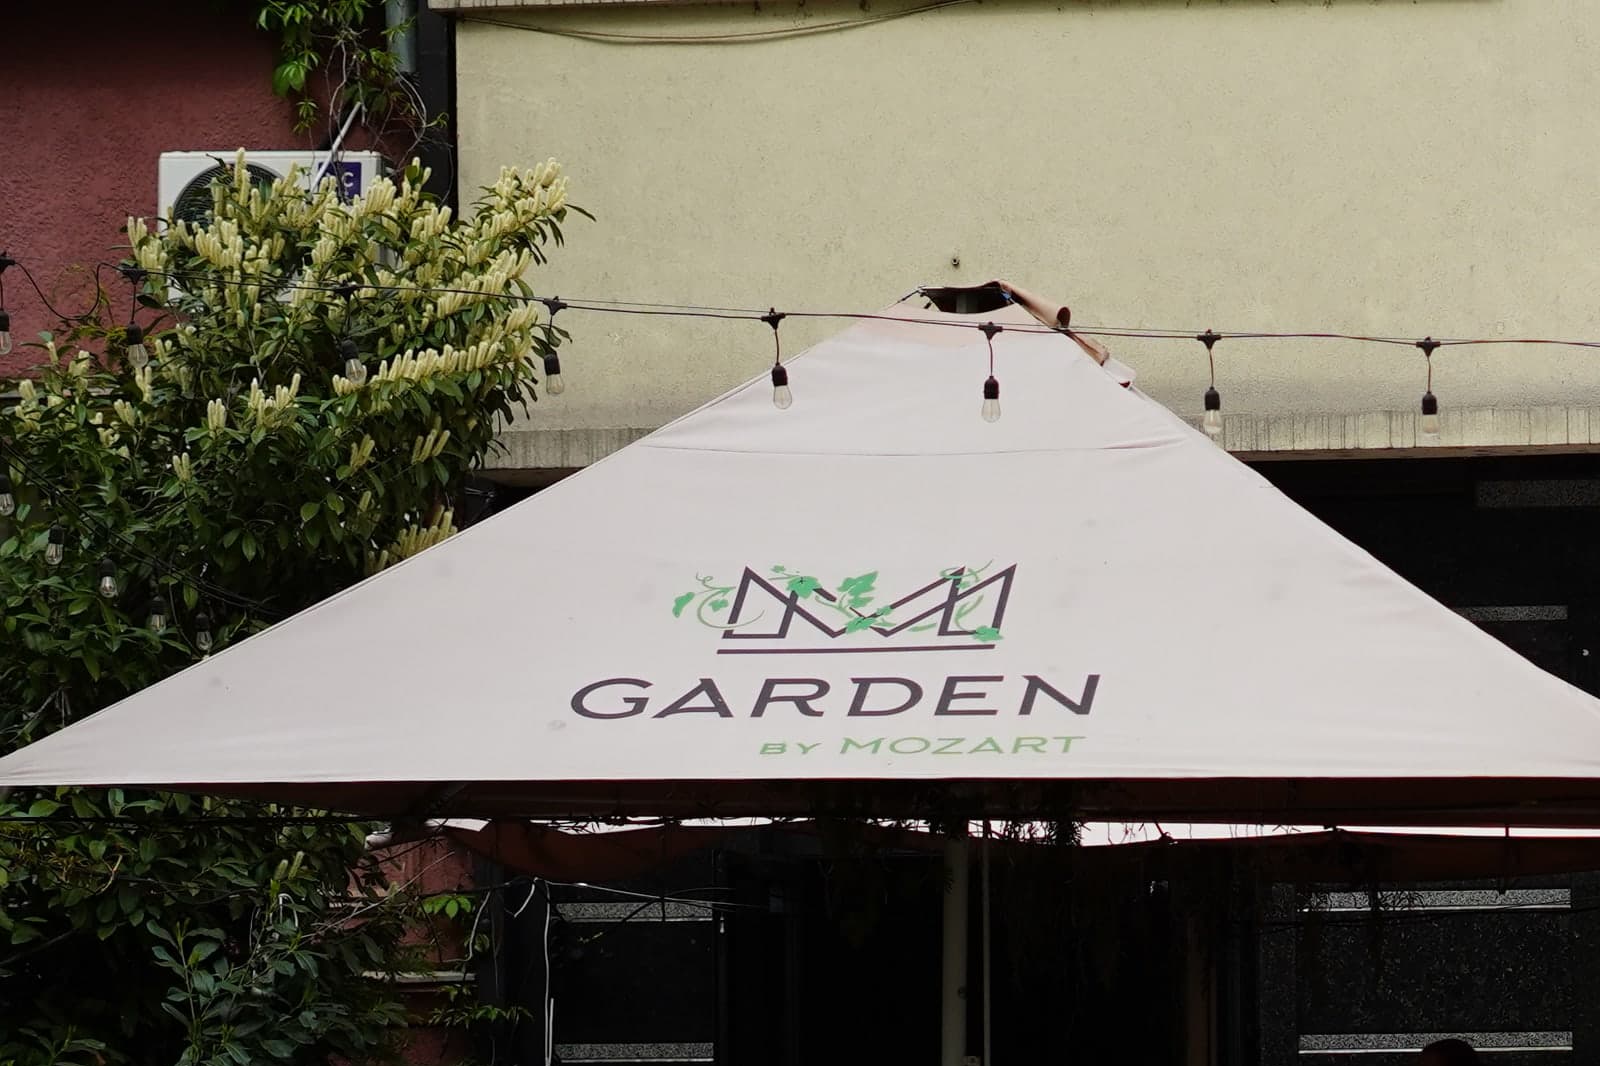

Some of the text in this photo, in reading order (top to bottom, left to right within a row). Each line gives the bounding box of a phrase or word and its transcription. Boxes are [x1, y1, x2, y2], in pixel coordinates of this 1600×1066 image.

[571, 674, 1100, 720] GARDEN
[760, 736, 1086, 755] BY MOZART
